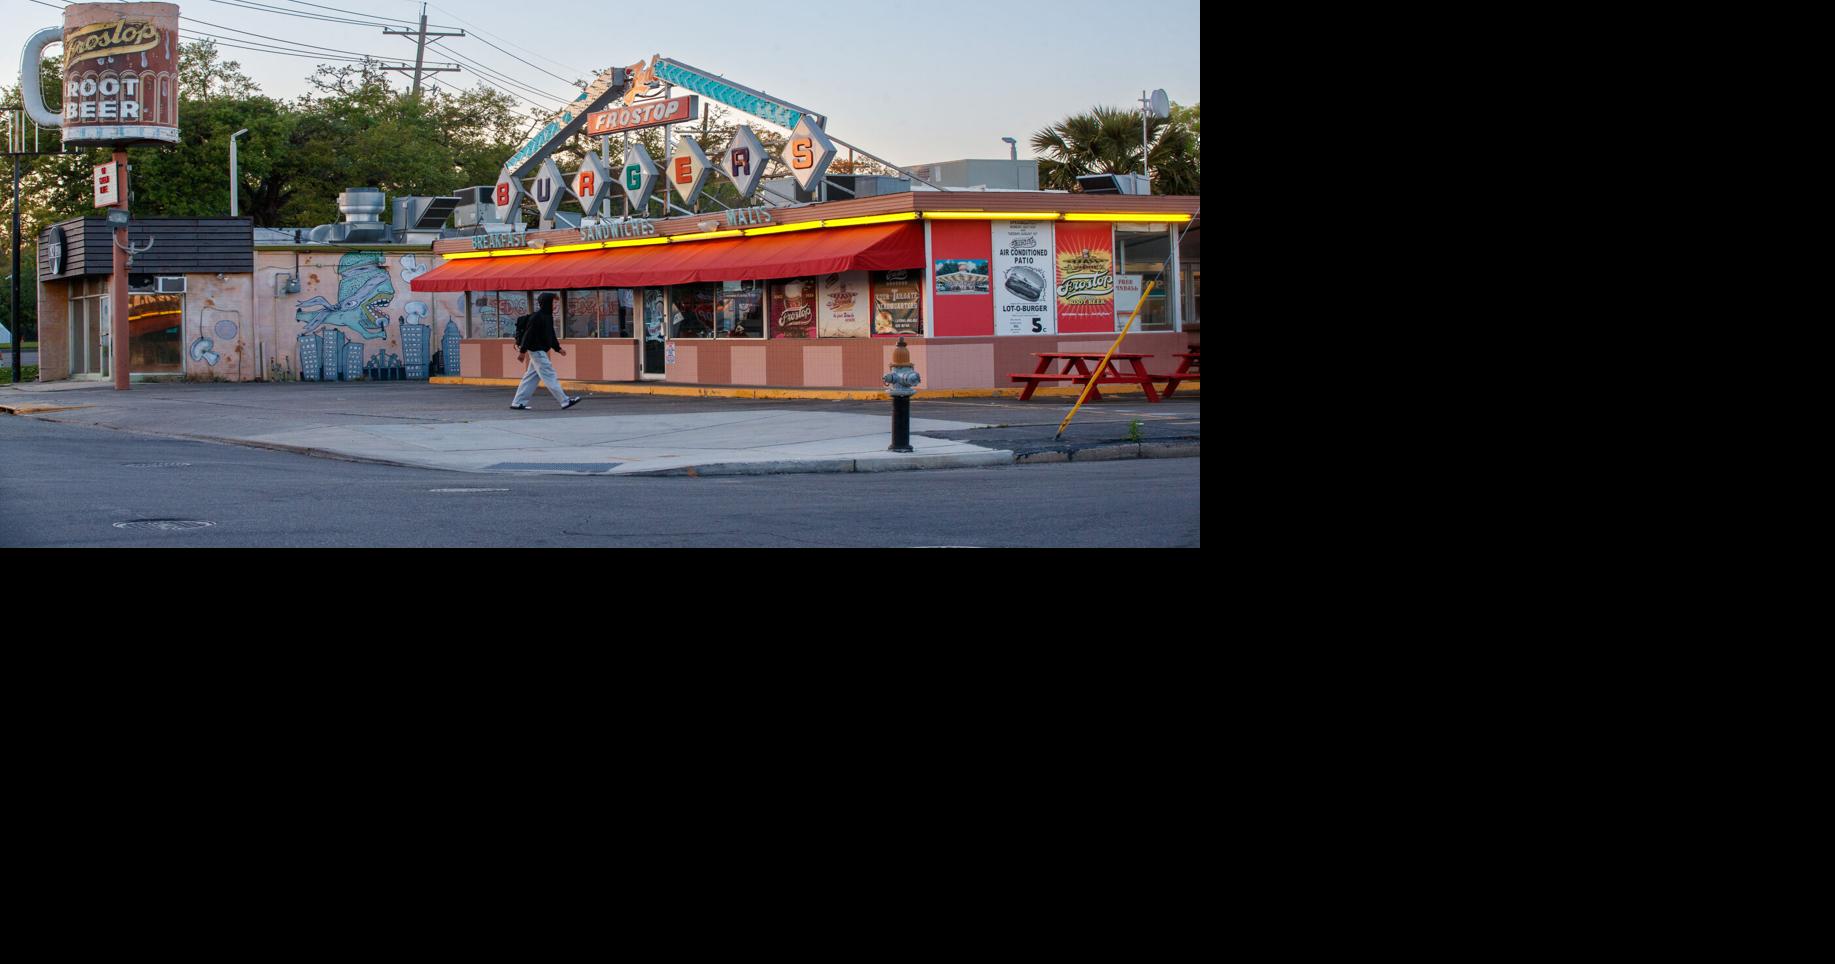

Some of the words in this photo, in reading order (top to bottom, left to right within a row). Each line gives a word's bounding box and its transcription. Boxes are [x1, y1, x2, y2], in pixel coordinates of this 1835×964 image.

[63, 18, 160, 69] Frostop
[66, 78, 139, 97] ROOT
[65, 100, 140, 119] BEER
[594, 100, 679, 130] FROSTOP
[496, 136, 814, 207] BURGERS
[726, 206, 773, 226] MALTS
[471, 231, 527, 249] BREAKFAST
[580, 217, 655, 241] SANDWICHES
[1000, 249, 1009, 257] AIR
[1010, 249, 1048, 257] CONDITIONED
[1057, 270, 1113, 300] Frostop
[778, 303, 813, 327] Frostop
